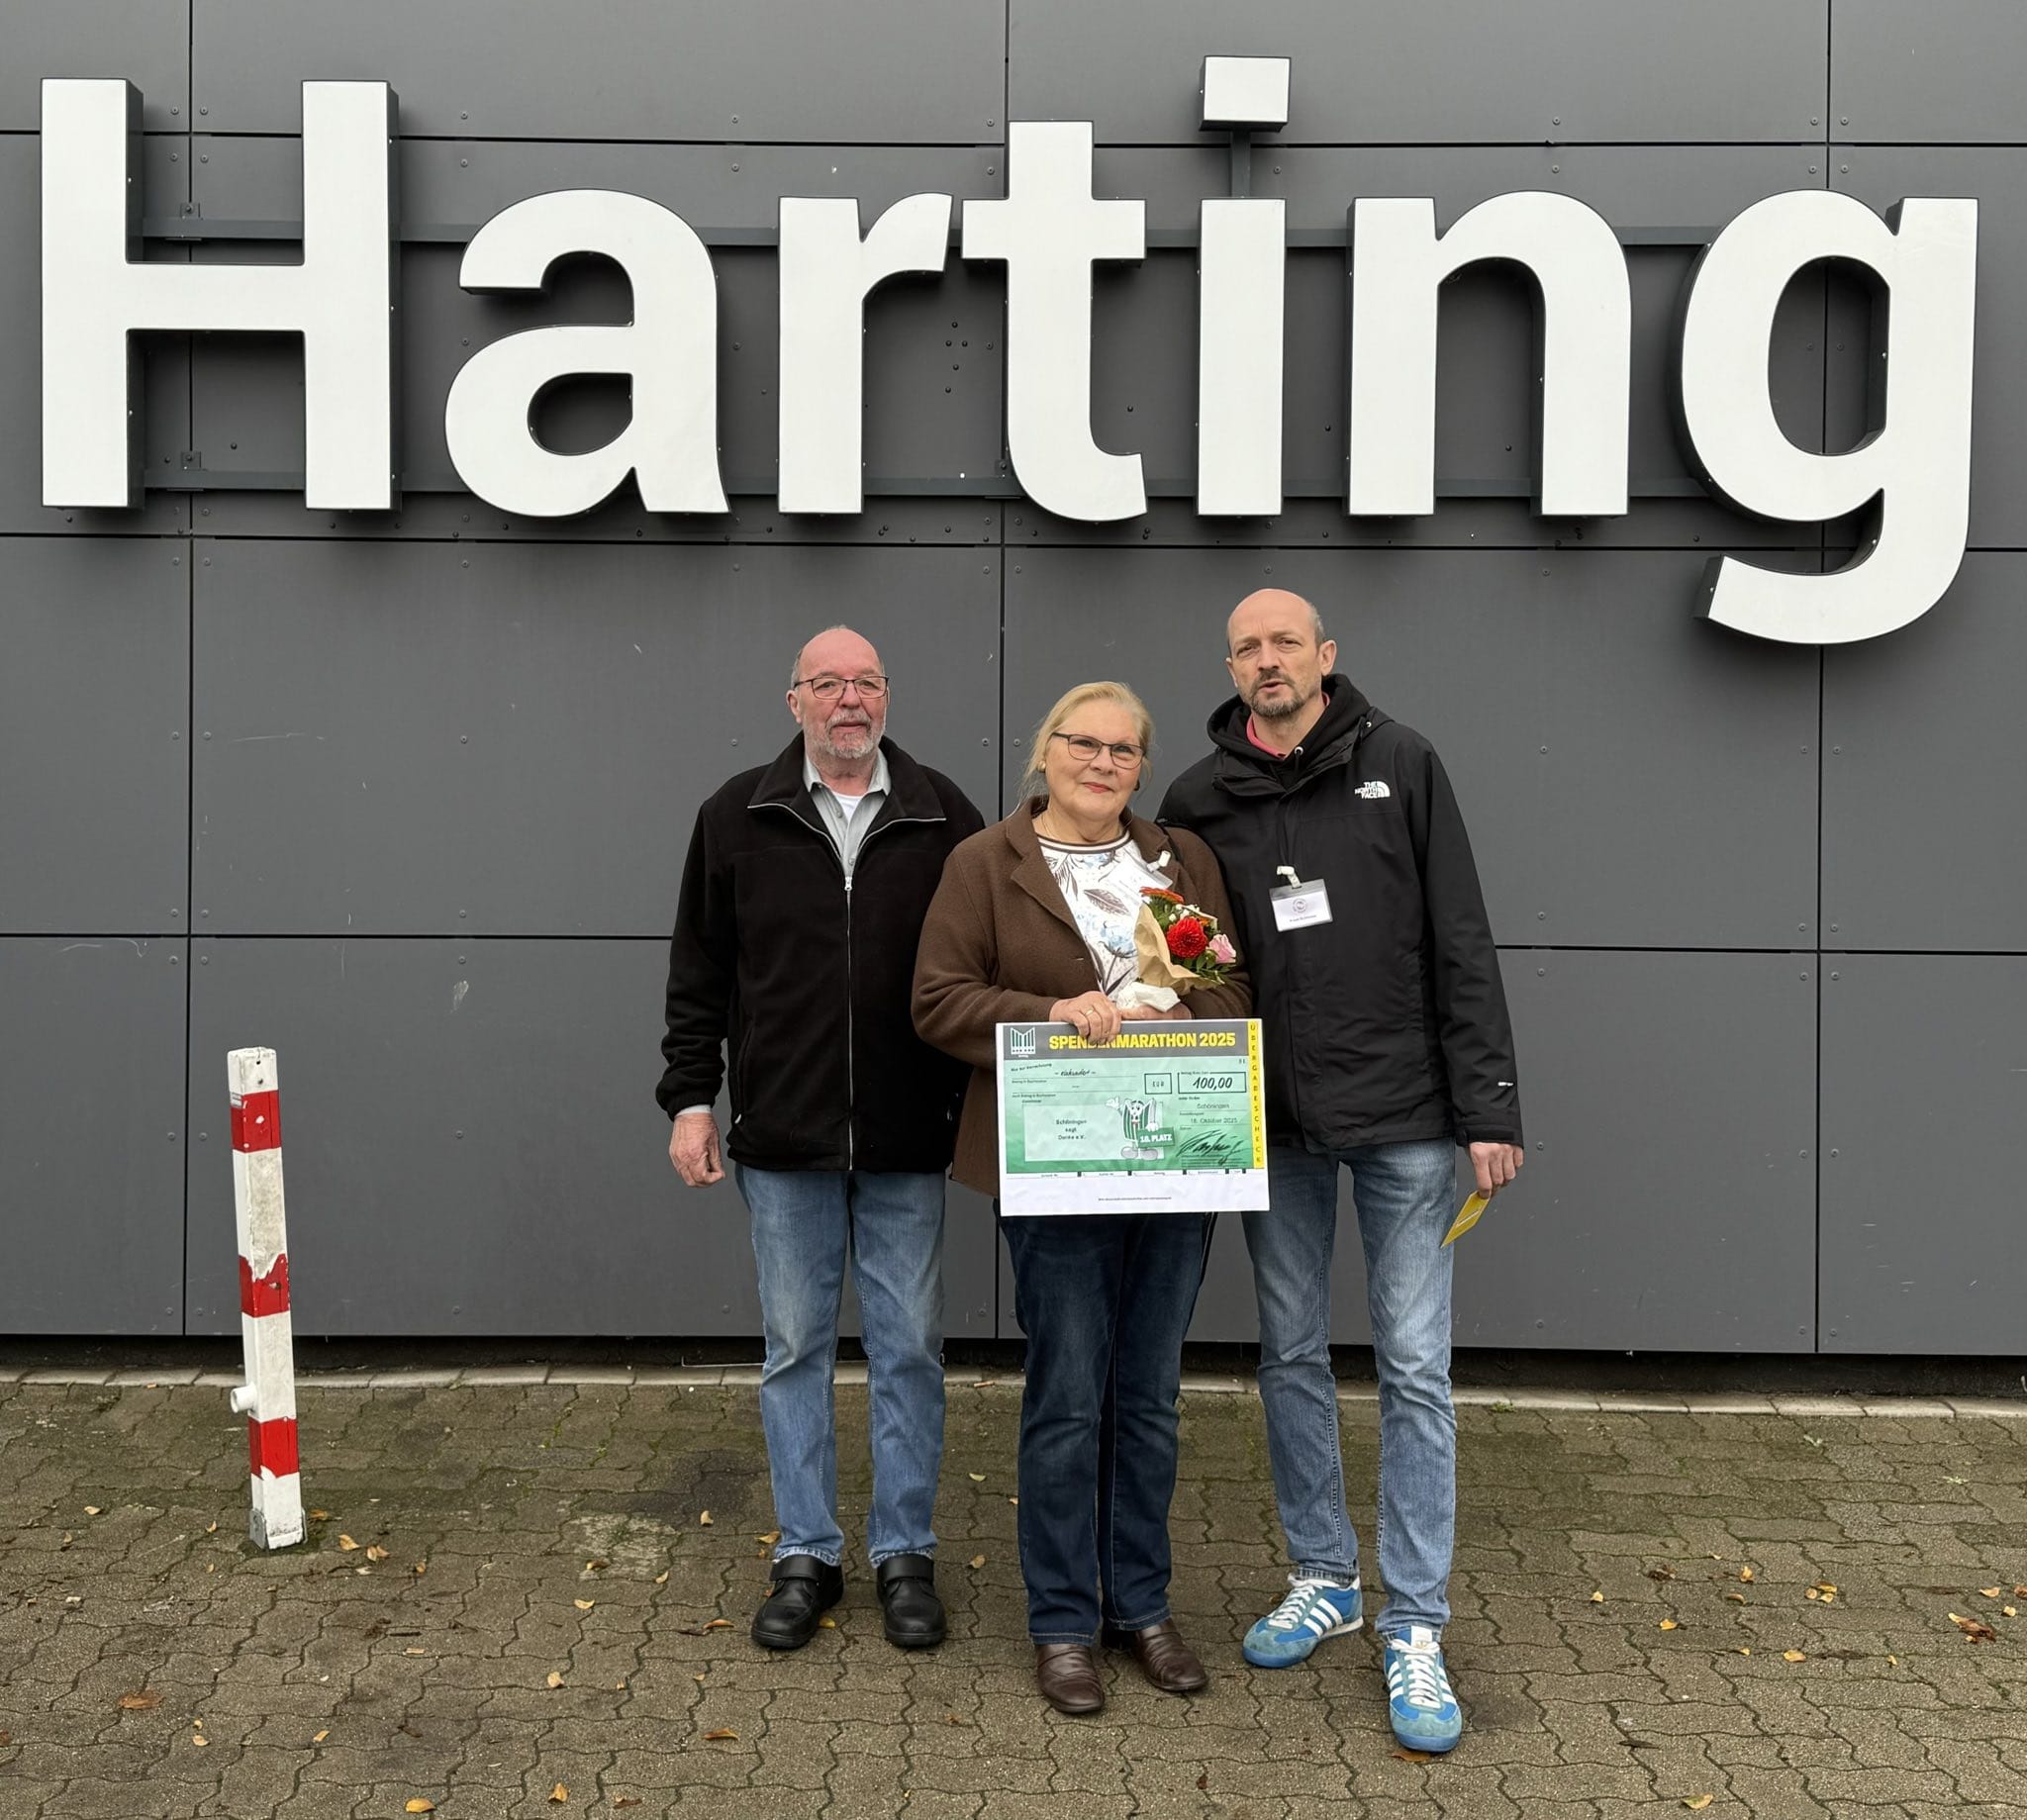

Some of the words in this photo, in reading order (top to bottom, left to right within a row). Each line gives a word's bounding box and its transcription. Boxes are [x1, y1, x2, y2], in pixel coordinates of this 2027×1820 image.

[40, 55, 1979, 644] Harting
[1049, 1032, 1198, 1050] SPENNMARATHON
[1200, 1032, 1236, 1048] 2025
[1193, 1077, 1233, 1091] 100,00
[1151, 1133, 1173, 1142] PLATZ
